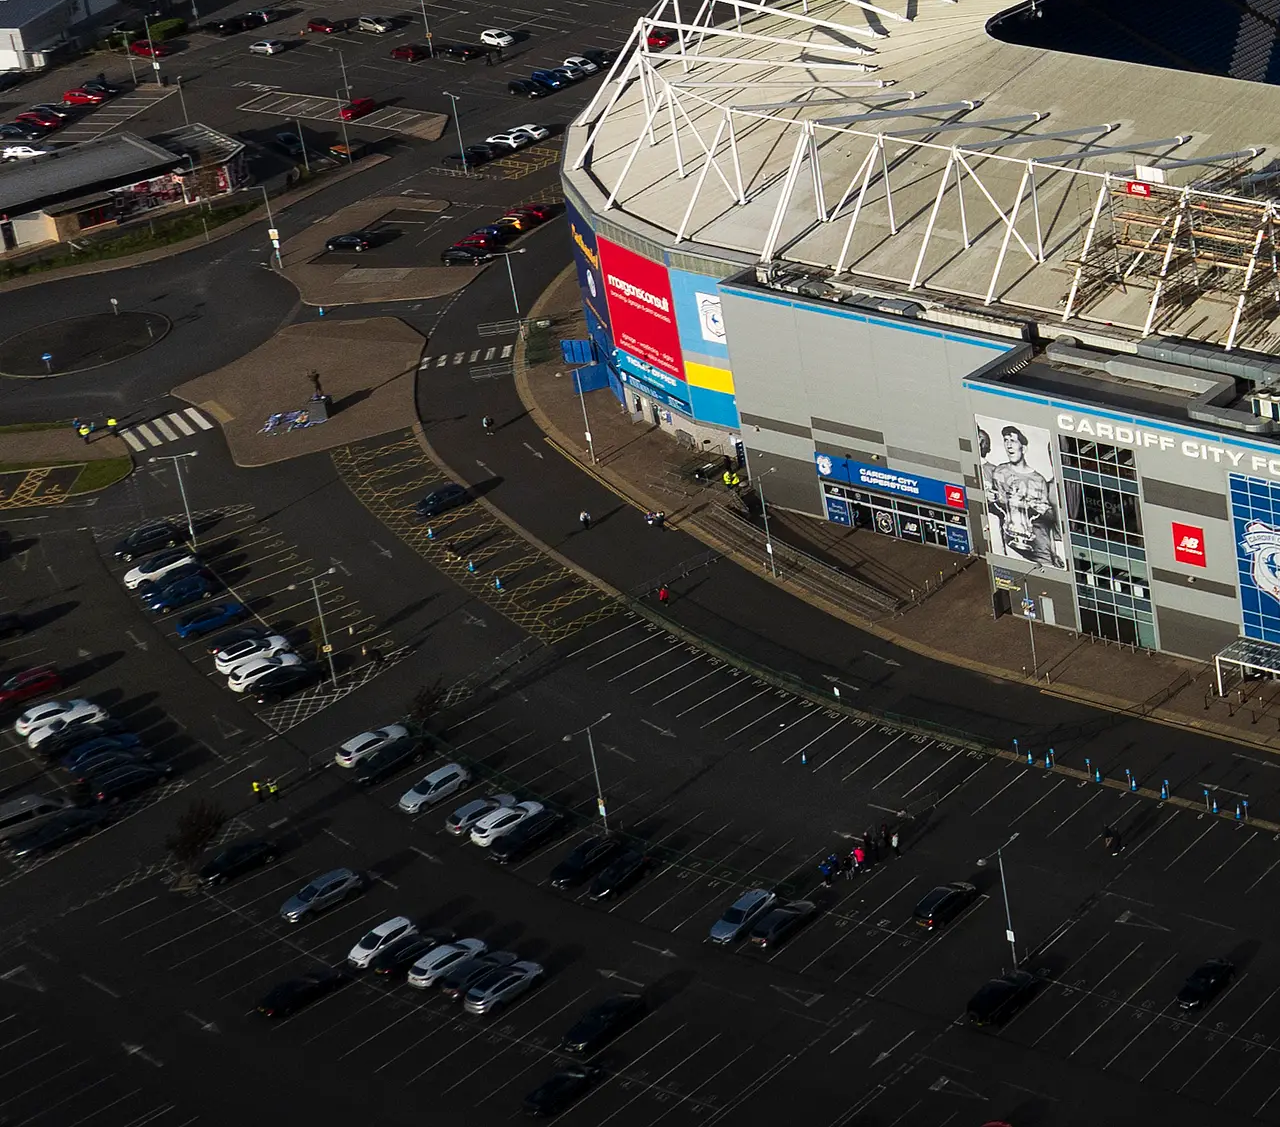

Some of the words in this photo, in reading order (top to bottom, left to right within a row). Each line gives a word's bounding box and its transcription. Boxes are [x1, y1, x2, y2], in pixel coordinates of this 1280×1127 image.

[1057, 413, 1176, 452] CARDIFF
[1180, 439, 1247, 468] CITY
[859, 467, 898, 484] CARDIFF
[897, 476, 918, 487] CITY
[860, 475, 920, 495] SUPERSTORE
[1247, 534, 1275, 545] CARDIFF
[644, 622, 657, 632] P2
[822, 709, 840, 719] P10
[966, 750, 986, 760] P15
